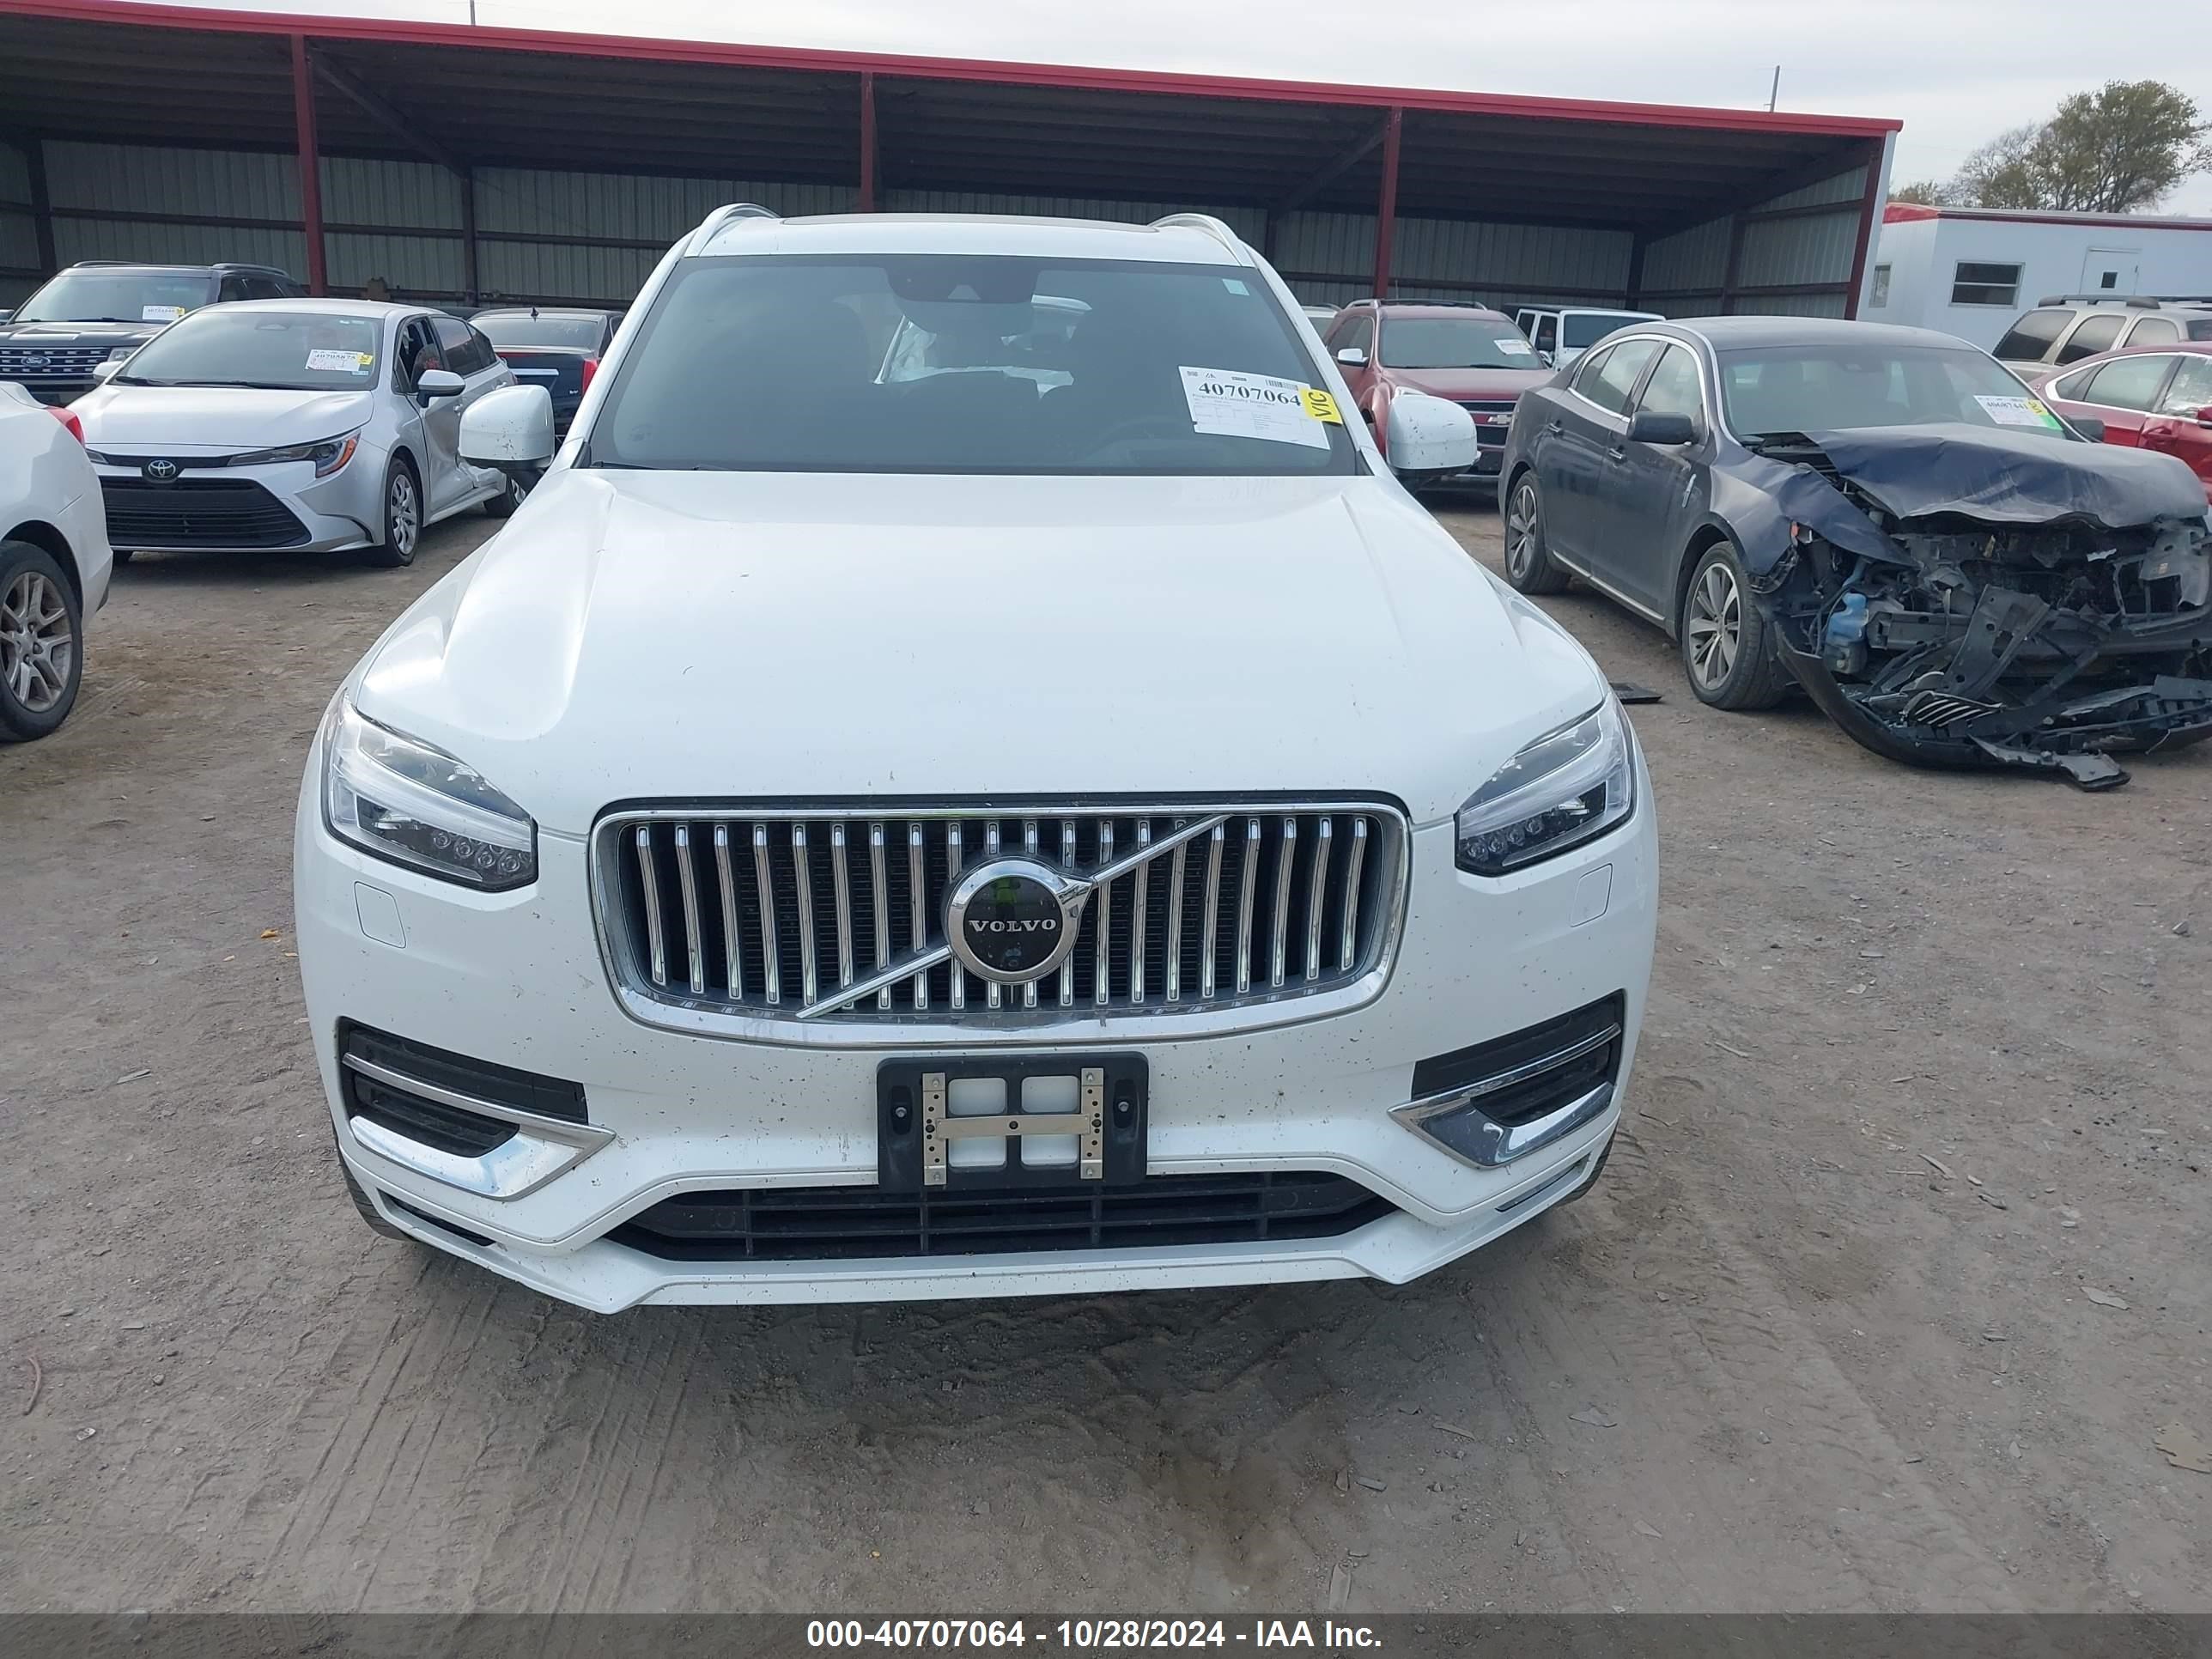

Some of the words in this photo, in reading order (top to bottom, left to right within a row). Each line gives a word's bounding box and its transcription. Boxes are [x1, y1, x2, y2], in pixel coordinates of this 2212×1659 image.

[1198, 381, 1302, 407] 40707064
[1308, 392, 1333, 417] VIC
[968, 919, 1057, 933] VOLVO
